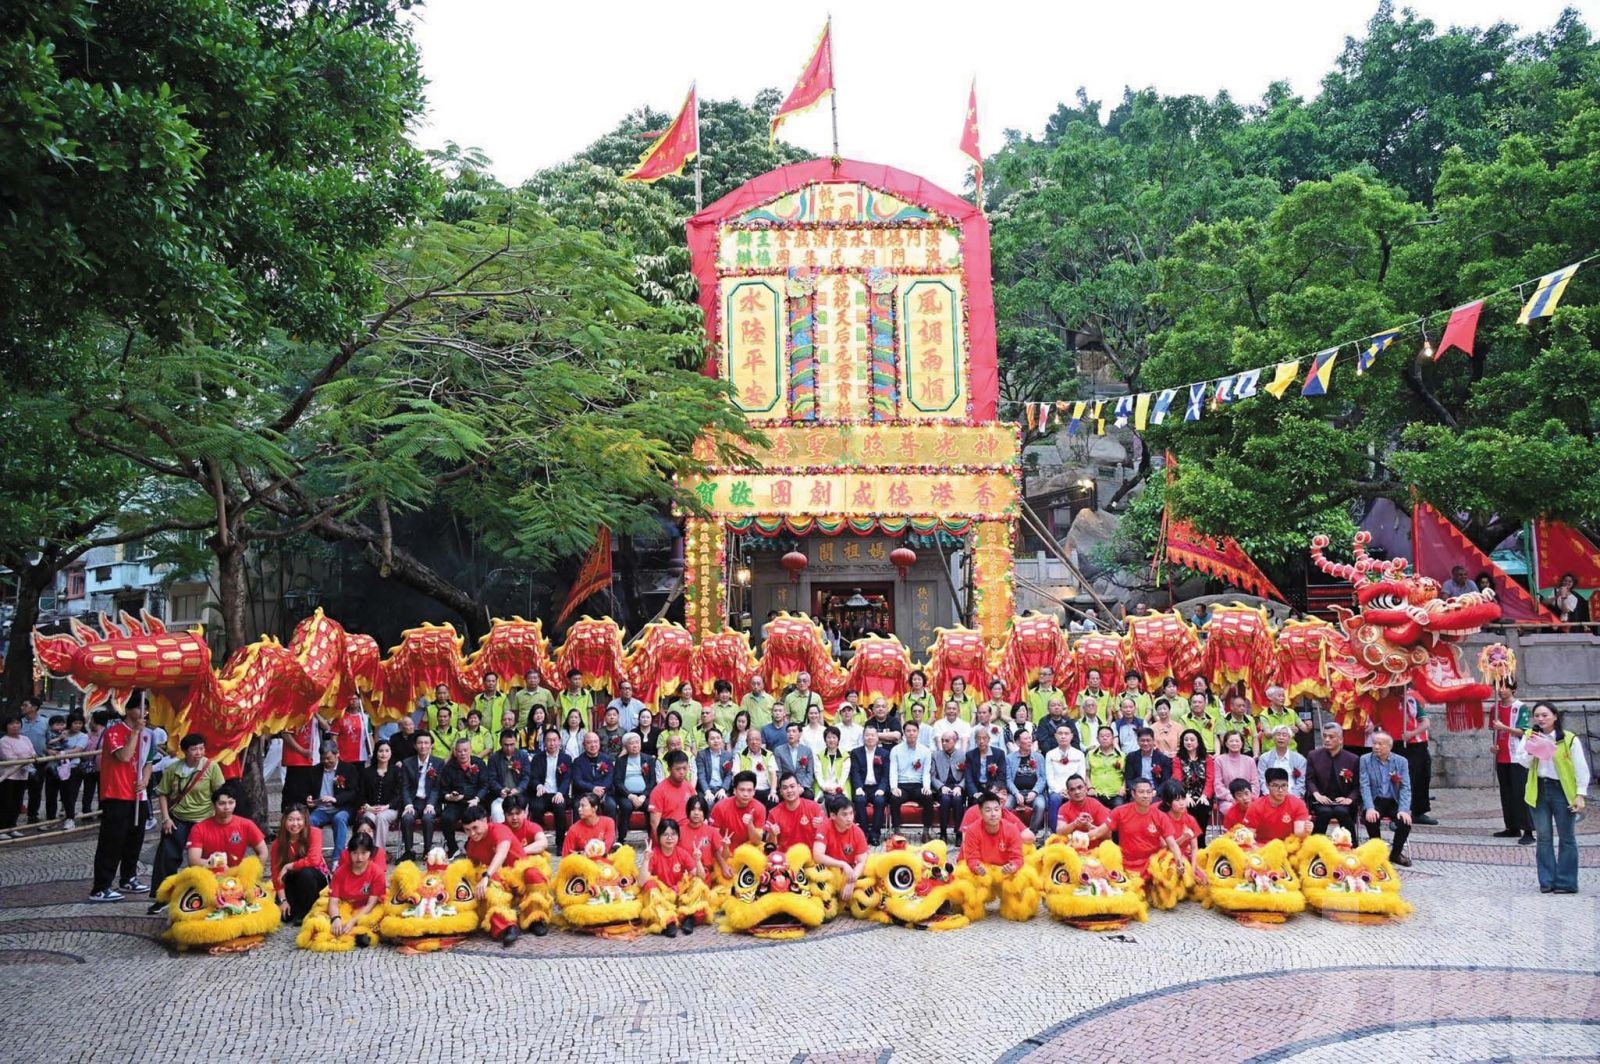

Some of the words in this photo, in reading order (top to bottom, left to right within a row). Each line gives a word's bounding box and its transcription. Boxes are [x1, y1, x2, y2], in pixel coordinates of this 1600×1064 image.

[740, 287, 767, 407] 水陸平安
[917, 288, 945, 402] 風調雨順
[818, 541, 888, 563] 媽祖閣
